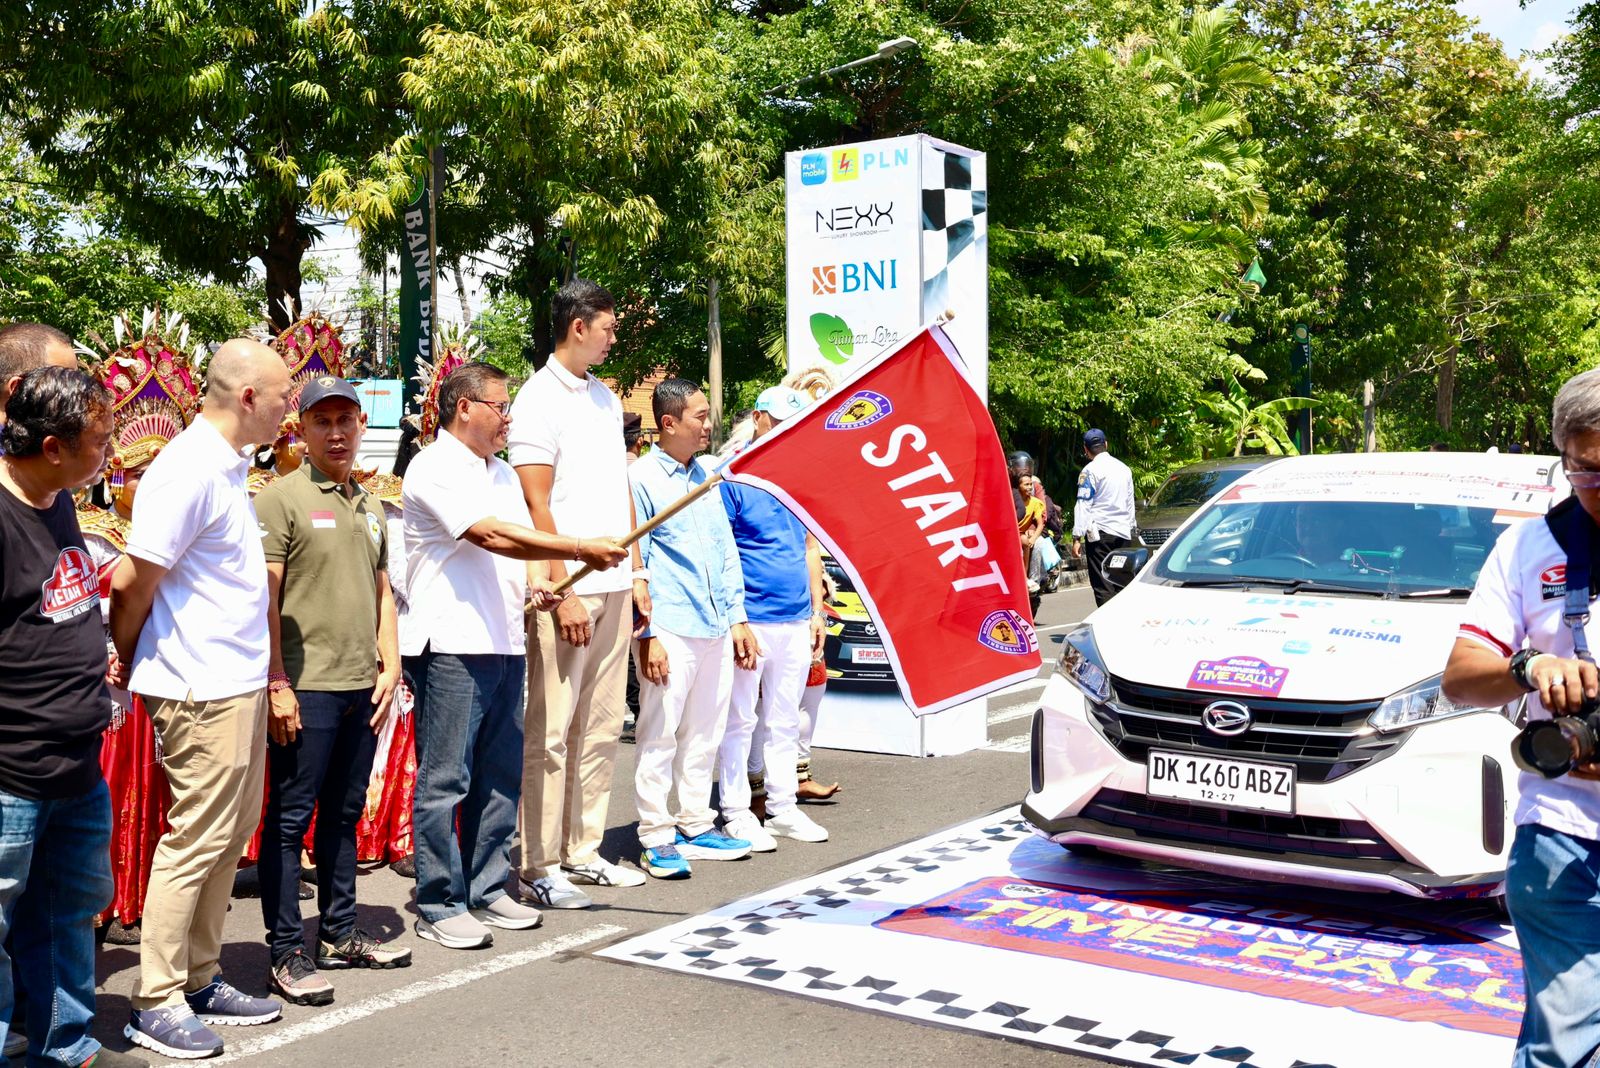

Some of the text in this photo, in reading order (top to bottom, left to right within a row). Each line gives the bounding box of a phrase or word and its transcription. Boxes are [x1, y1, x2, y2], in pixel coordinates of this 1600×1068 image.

[802, 169, 825, 177] mobile
[863, 148, 908, 171] PLN
[815, 201, 894, 233] NEXX
[404, 208, 431, 291] BANK
[842, 259, 897, 293] BNI
[828, 325, 898, 347] Taman Loka
[860, 423, 1011, 596] START
[1512, 491, 1533, 503] 11
[45, 584, 82, 610] MERAH
[82, 572, 99, 594] PUTI
[1542, 585, 1567, 593] DAIHA
[1014, 614, 1038, 645] BALI
[1196, 670, 1232, 681] TIME
[1233, 672, 1280, 689] RALLY
[1153, 756, 1288, 796] DK 1460 ABZ
[1086, 901, 1493, 974] INDONESIA
[1188, 900, 1437, 941] 2025
[963, 898, 1526, 1012] TIME RALL
[1109, 941, 1386, 993] Championship
